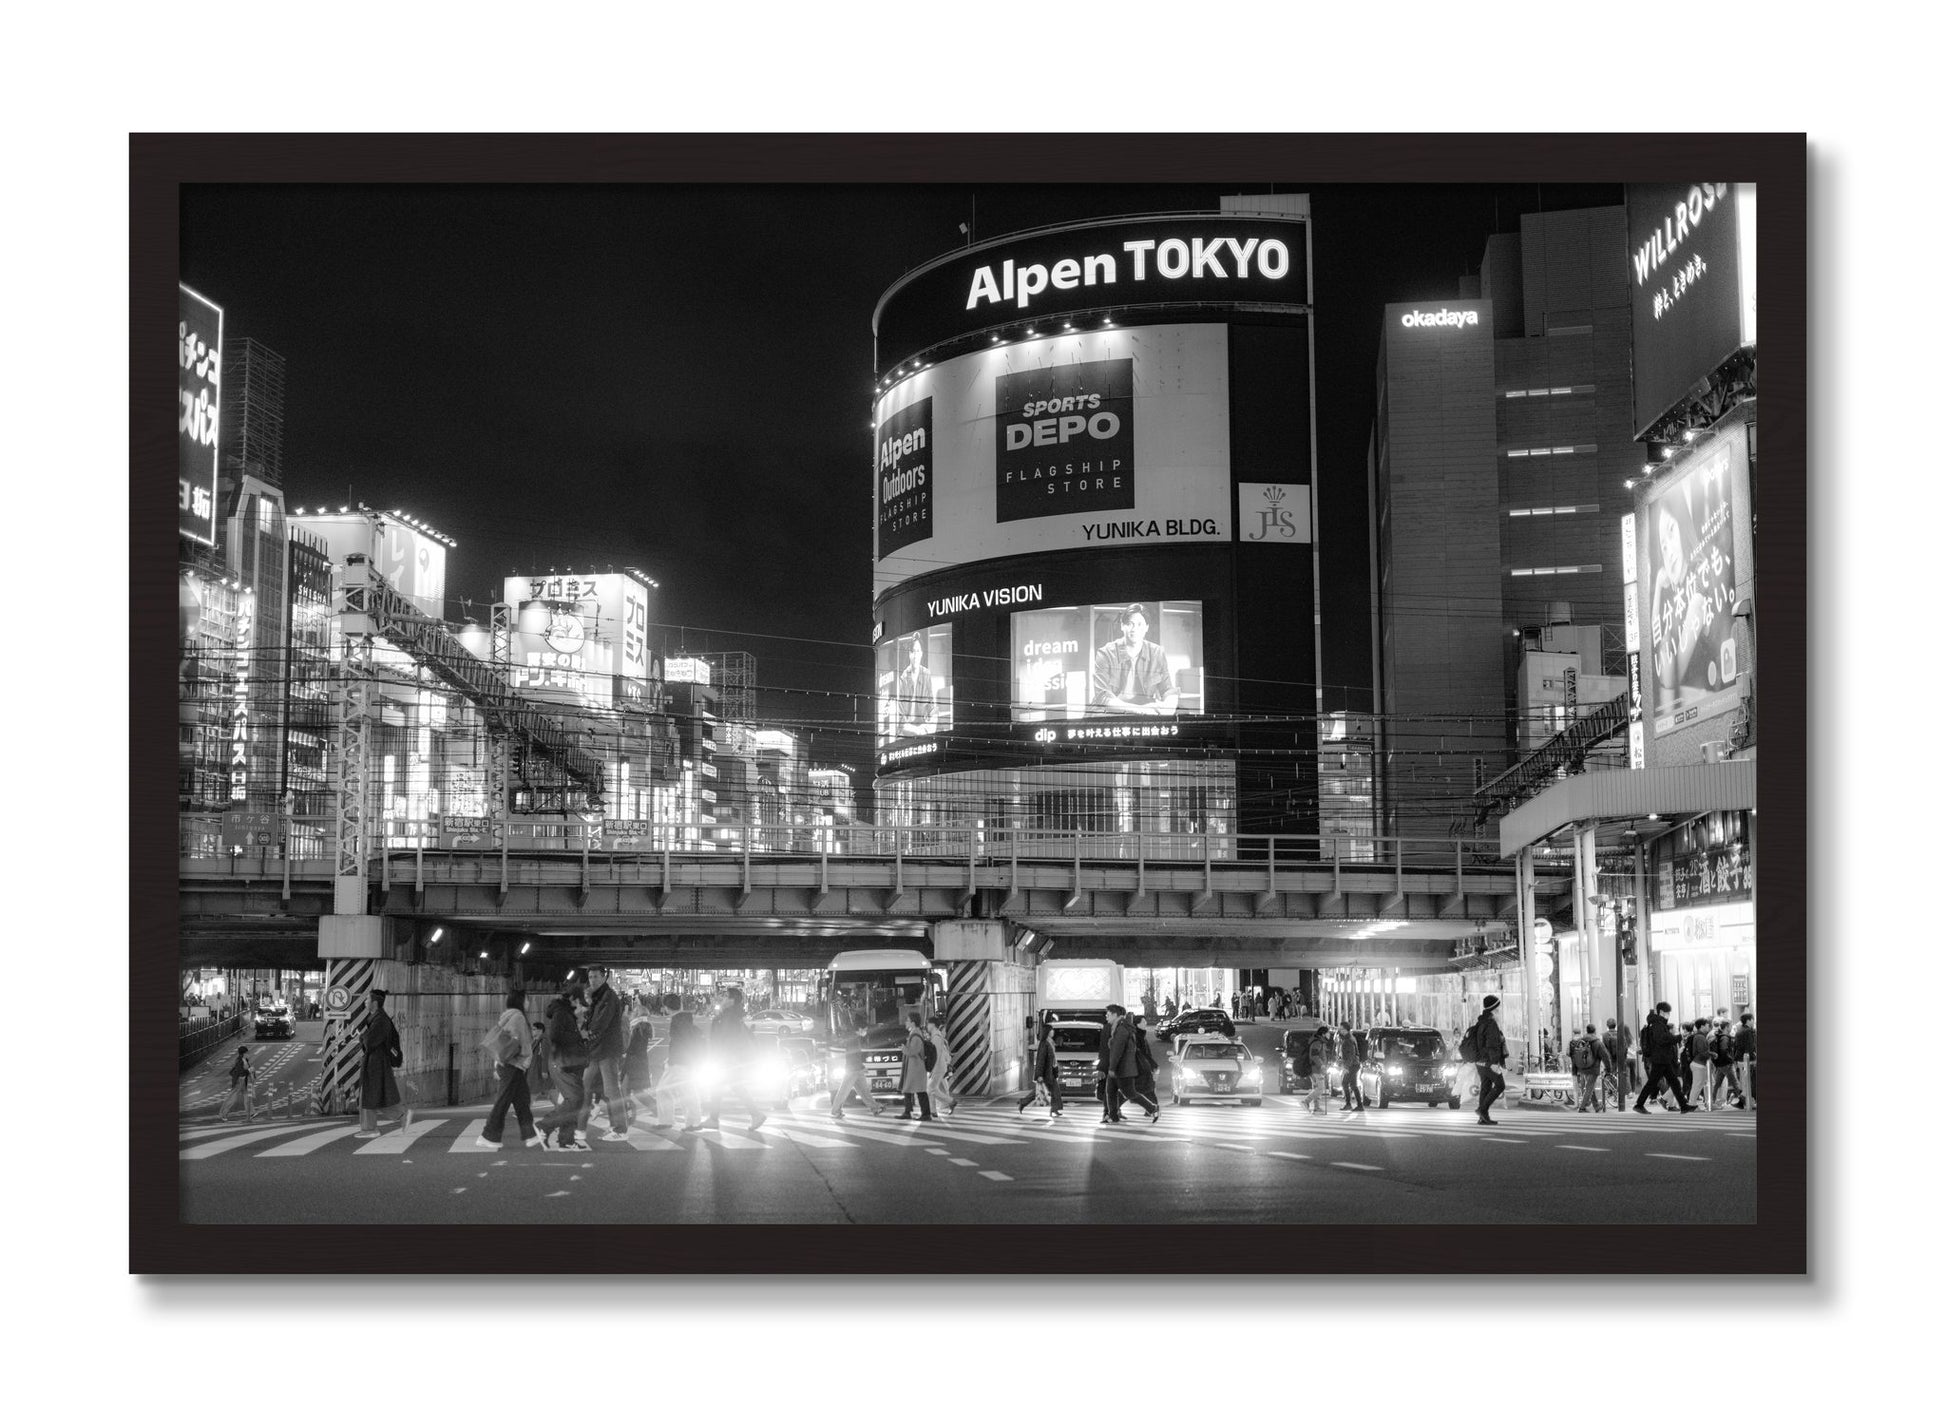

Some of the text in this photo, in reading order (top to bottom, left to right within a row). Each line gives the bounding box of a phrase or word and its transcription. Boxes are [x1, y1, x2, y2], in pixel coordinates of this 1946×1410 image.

[1634, 183, 1727, 287] WILLROS
[965, 237, 1290, 310] Alpen TOKYO
[1402, 308, 1479, 329] okadaya
[179, 386, 217, 447] スパス
[1022, 393, 1101, 418] SPORTS
[1006, 411, 1121, 451] DEPO
[880, 427, 926, 472] Alpen
[882, 464, 925, 504] Outdoors
[1006, 459, 1121, 483] FLAGSHIP
[1047, 477, 1121, 494] STORE
[880, 492, 926, 525] FLAGSHIP
[893, 508, 926, 531] STORE
[1082, 518, 1221, 541] YUNIKA BLDG.
[298, 584, 327, 605] SHISHA
[529, 579, 598, 599] プロミス
[927, 583, 1043, 618] YUNIKA VISION
[1651, 545, 1731, 648] 自分本位でも、
[626, 595, 645, 666] プロミス
[1654, 582, 1736, 677] いいじゃない。
[1023, 639, 1079, 657] dream
[1034, 726, 1179, 743] dip 夢を叶える仕事に出会おう
